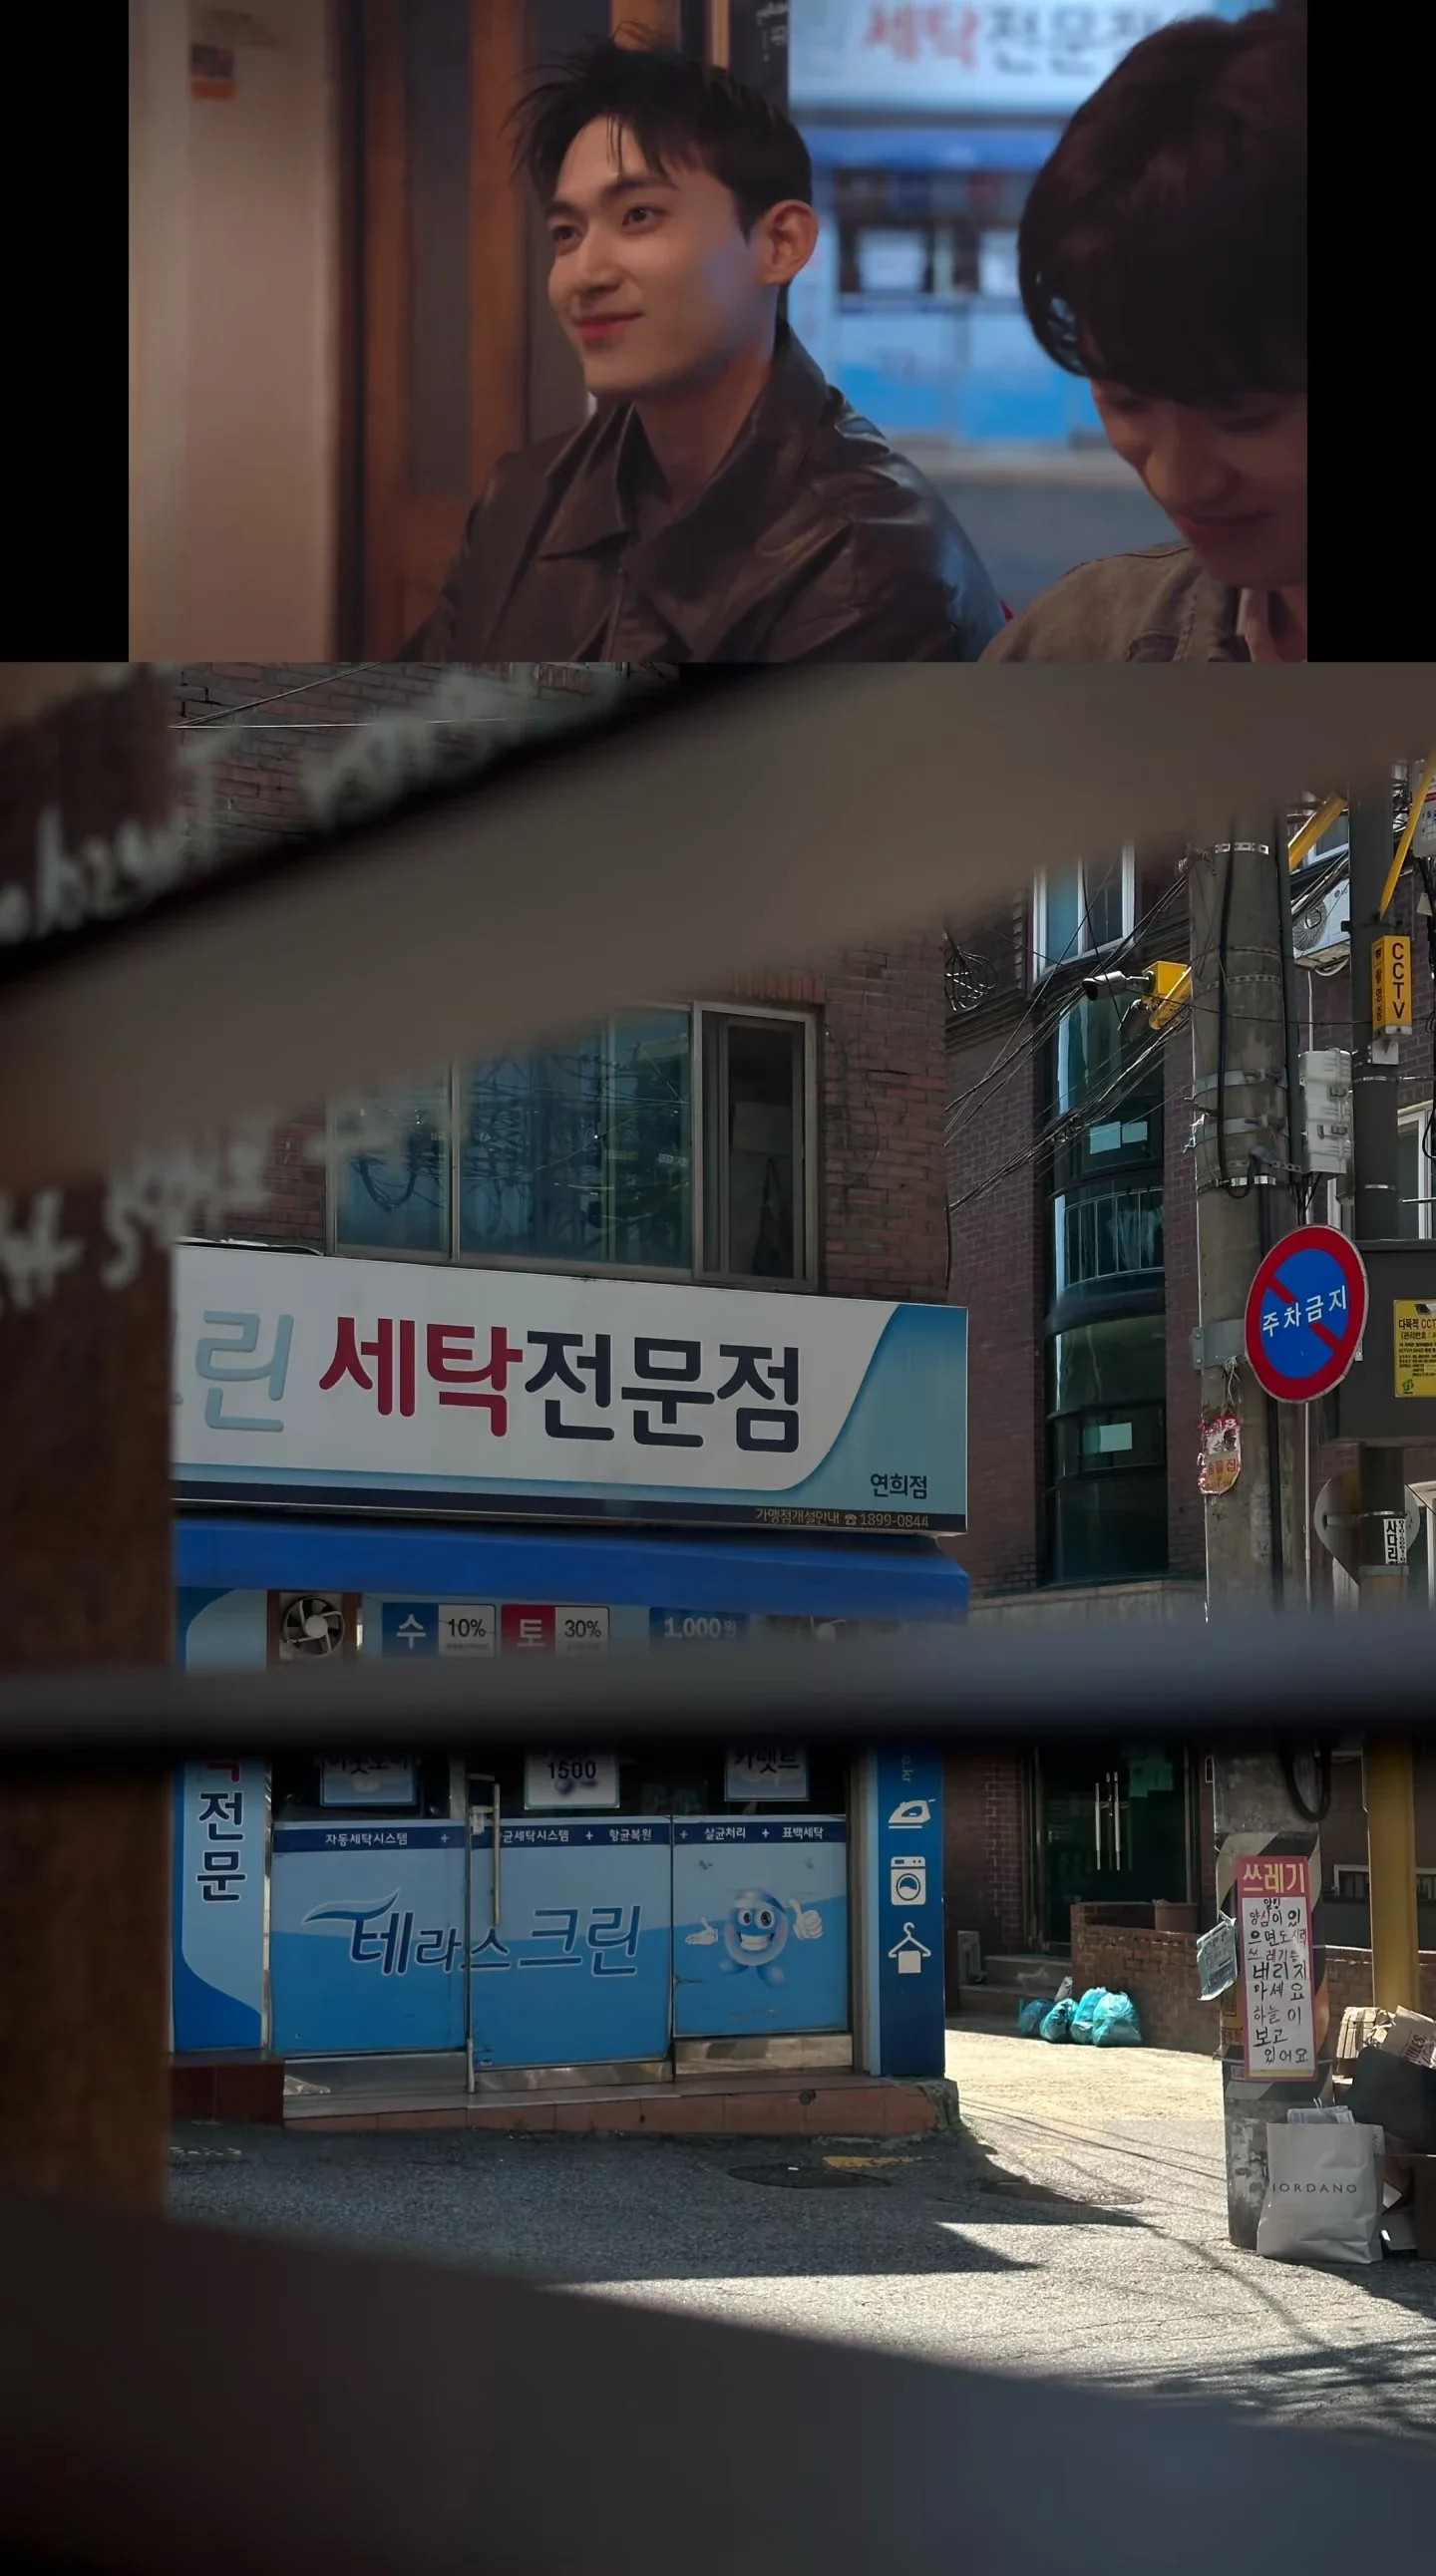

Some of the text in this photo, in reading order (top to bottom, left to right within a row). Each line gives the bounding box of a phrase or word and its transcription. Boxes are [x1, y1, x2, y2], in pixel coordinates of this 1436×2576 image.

[1392, 942, 1404, 1019] CCTV
[1262, 1285, 1346, 1337] 주차금지
[318, 1316, 801, 1453] 세탁전문점
[870, 1472, 927, 1499] 연희점
[756, 1508, 929, 1528] 가맹점개설안내 1899-0844
[396, 1613, 487, 1650] 수 10%
[517, 1619, 602, 1647] 토 30%
[547, 1761, 596, 1779] 1500
[325, 1832, 408, 1846] 자동세탁시스템
[499, 1829, 569, 1843] 균세탁시스템
[608, 1828, 652, 1842] 항균복원
[704, 1826, 746, 1839] 살균처리
[782, 1826, 824, 1839] 표백세탁
[1243, 1863, 1305, 1893] 쓰레기
[1250, 1908, 1282, 1928] 양심이
[302, 1887, 643, 1978] 테라스크린
[1253, 1960, 1306, 1981] 버리지
[1253, 2027, 1288, 2048] 보고
[1264, 2046, 1308, 2065] 있어요
